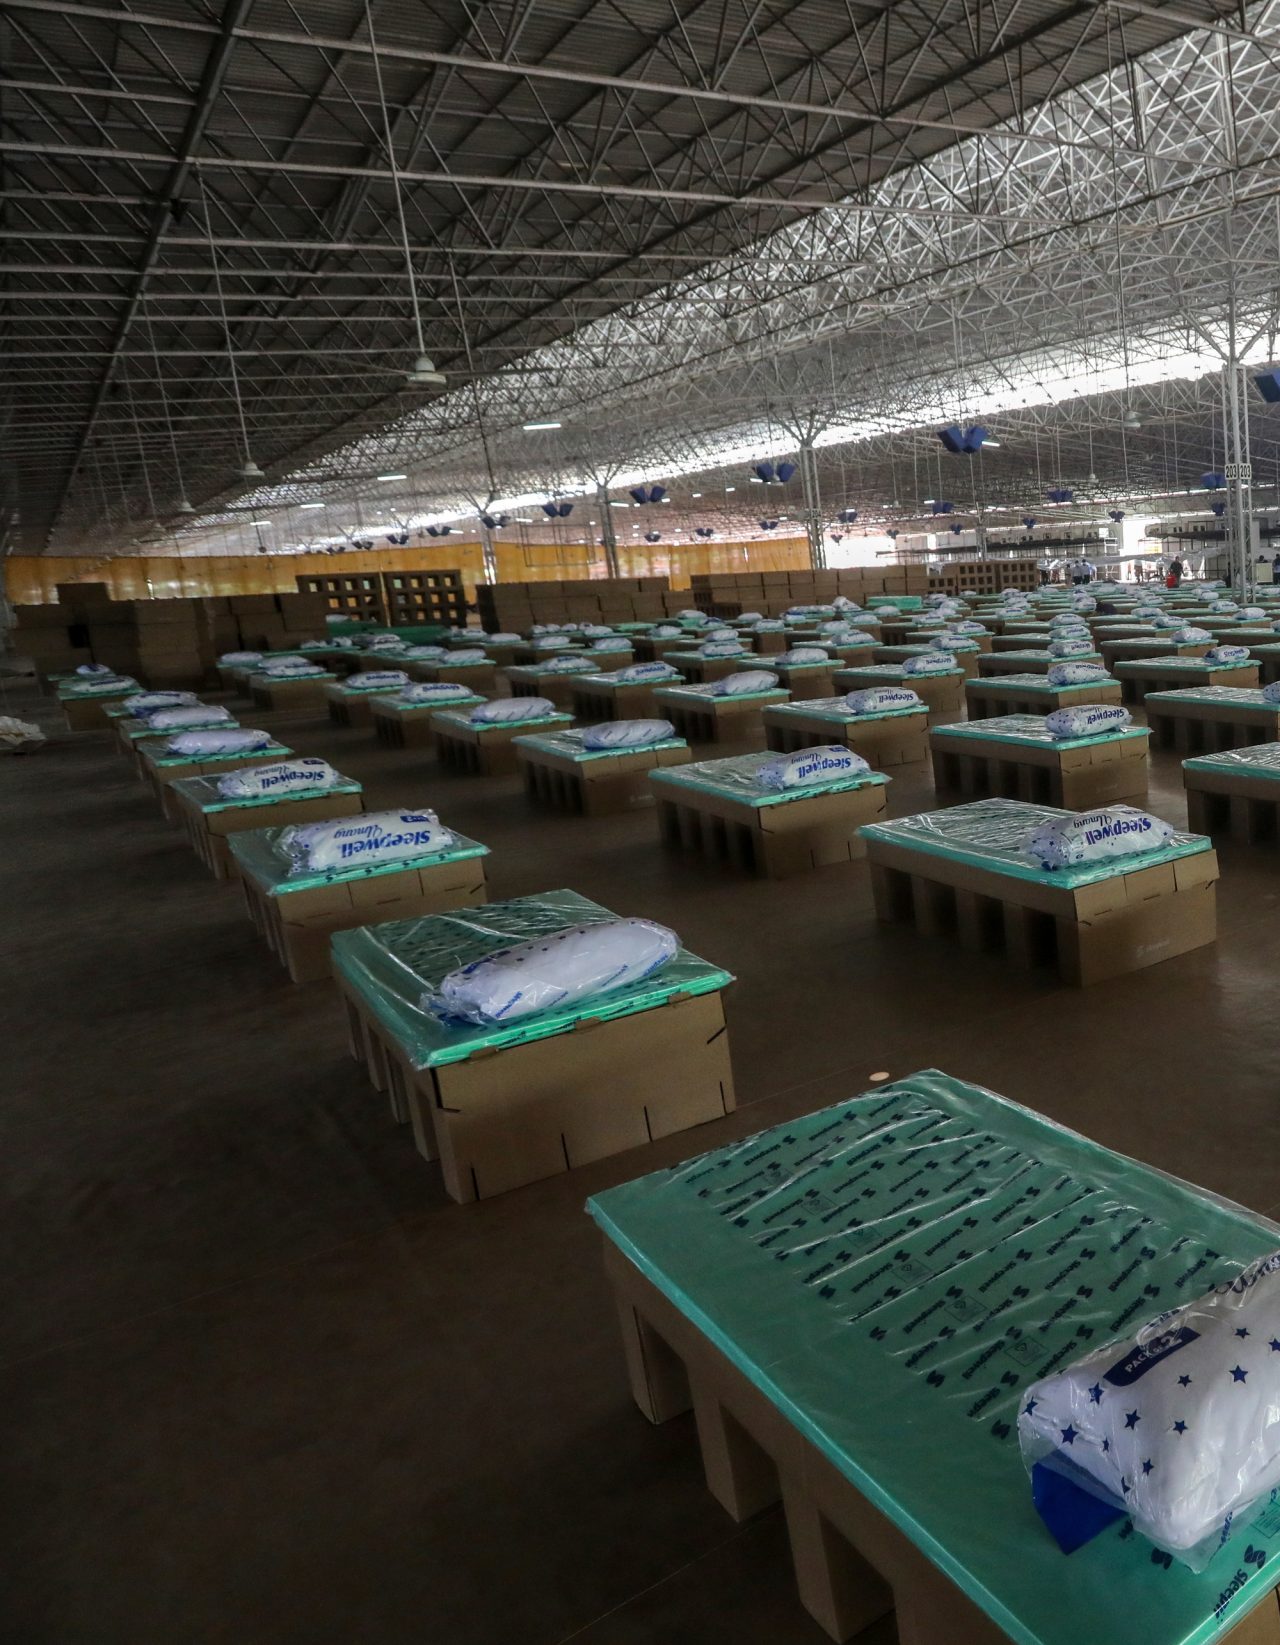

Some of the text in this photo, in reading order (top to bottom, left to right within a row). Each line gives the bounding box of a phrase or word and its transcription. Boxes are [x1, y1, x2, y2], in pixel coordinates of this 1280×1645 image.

[1225, 465, 1237, 478] 203
[1240, 465, 1251, 478] 203
[341, 830, 431, 858] Sleepwell
[1085, 817, 1152, 846] Sleepwell
[1125, 1347, 1153, 1373] PACK
